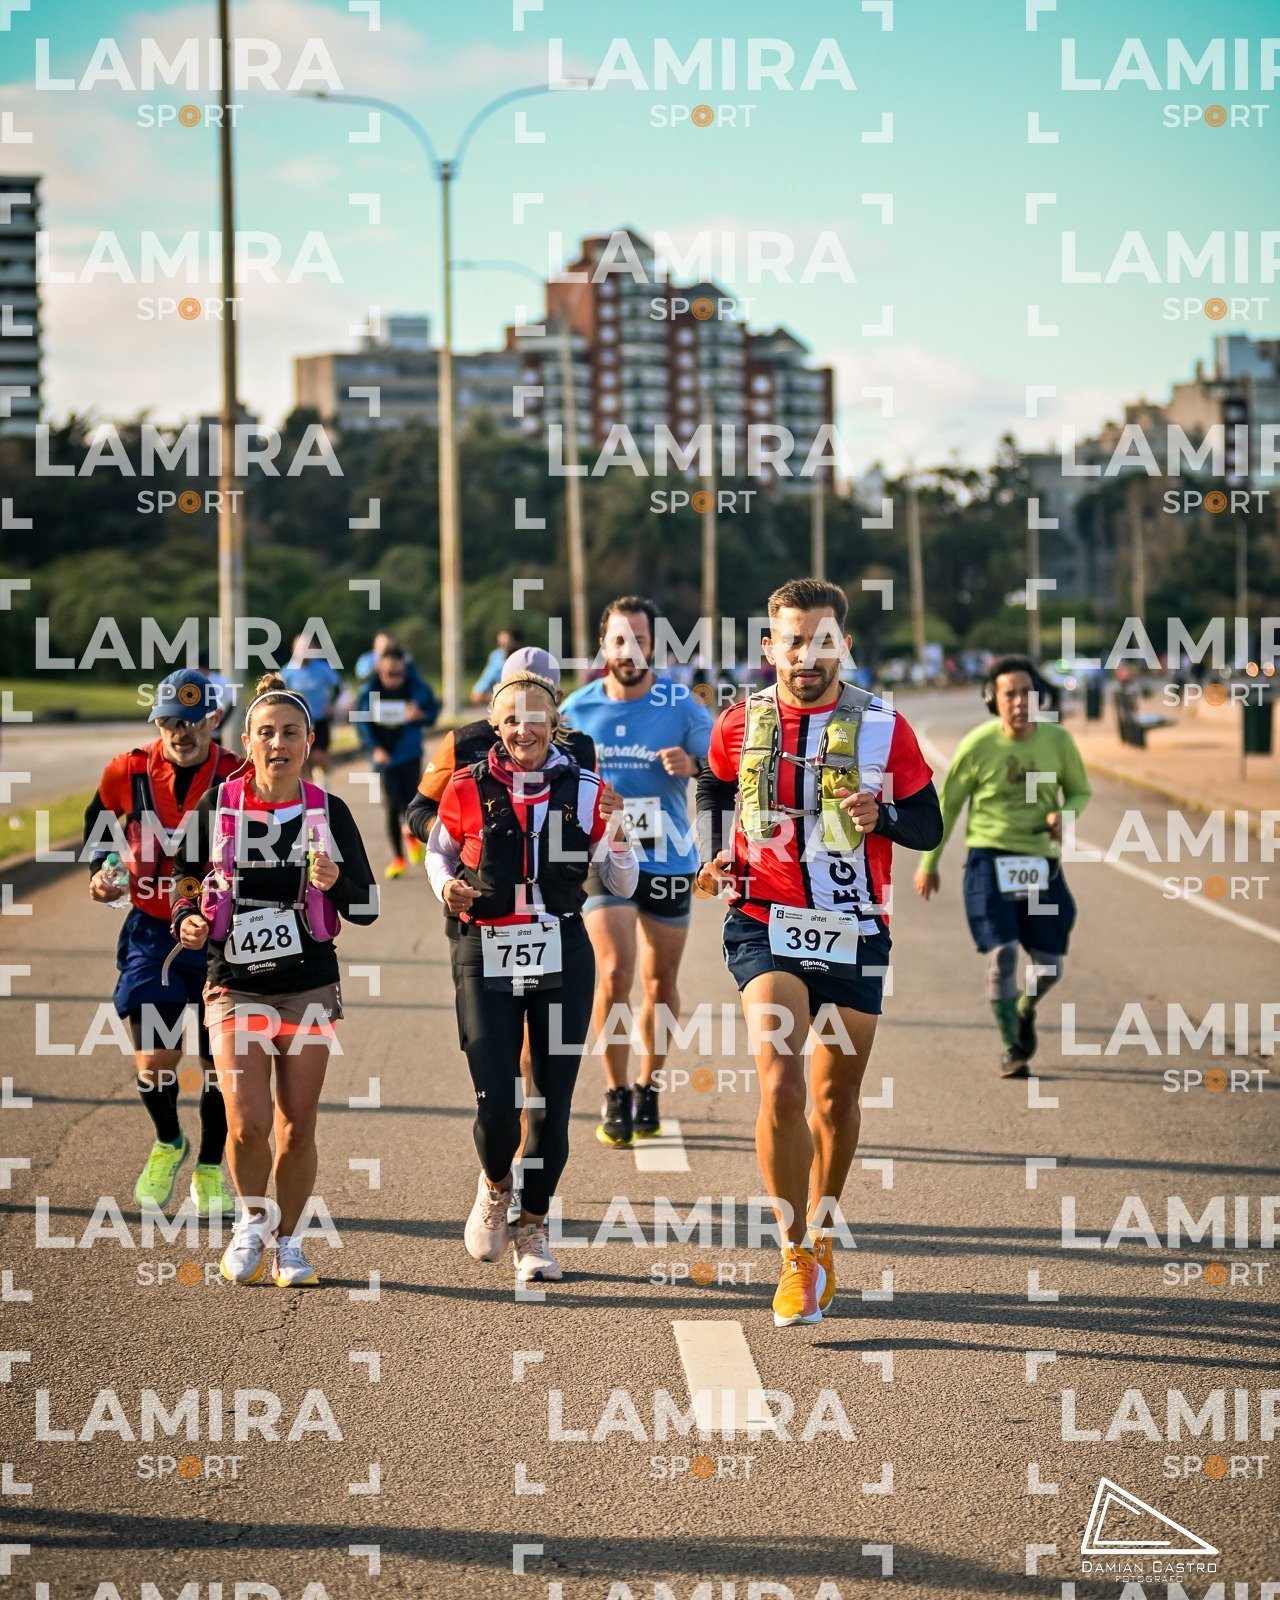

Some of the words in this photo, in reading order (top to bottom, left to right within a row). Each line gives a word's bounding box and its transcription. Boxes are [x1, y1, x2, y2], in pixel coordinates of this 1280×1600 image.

[1008, 868, 1039, 885] 700
[810, 914, 827, 922] antel
[228, 924, 292, 956] 1428
[786, 926, 842, 954] 397
[496, 942, 547, 968] 757
